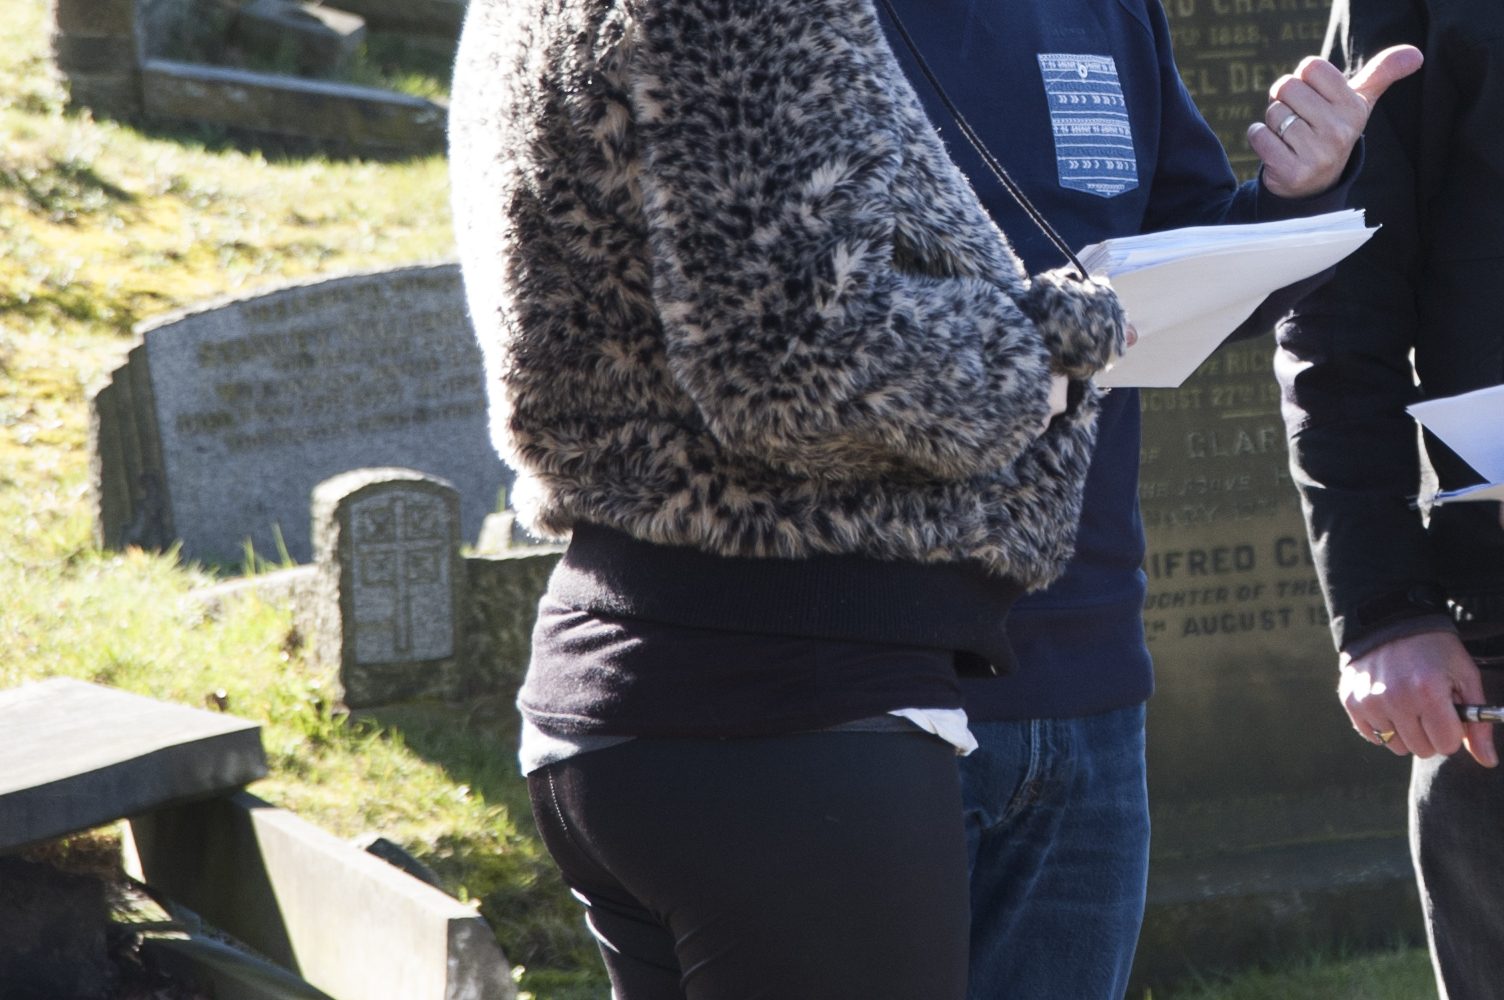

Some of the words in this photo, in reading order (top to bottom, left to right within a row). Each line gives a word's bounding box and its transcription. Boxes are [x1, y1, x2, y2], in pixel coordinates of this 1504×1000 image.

[1180, 67, 1218, 98] EL
[1186, 426, 1282, 460] CLAR
[1146, 586, 1230, 611] UGHTER
[1235, 584, 1265, 603] OF
[1276, 578, 1322, 600] THE
[1182, 606, 1293, 639] AUGUST
